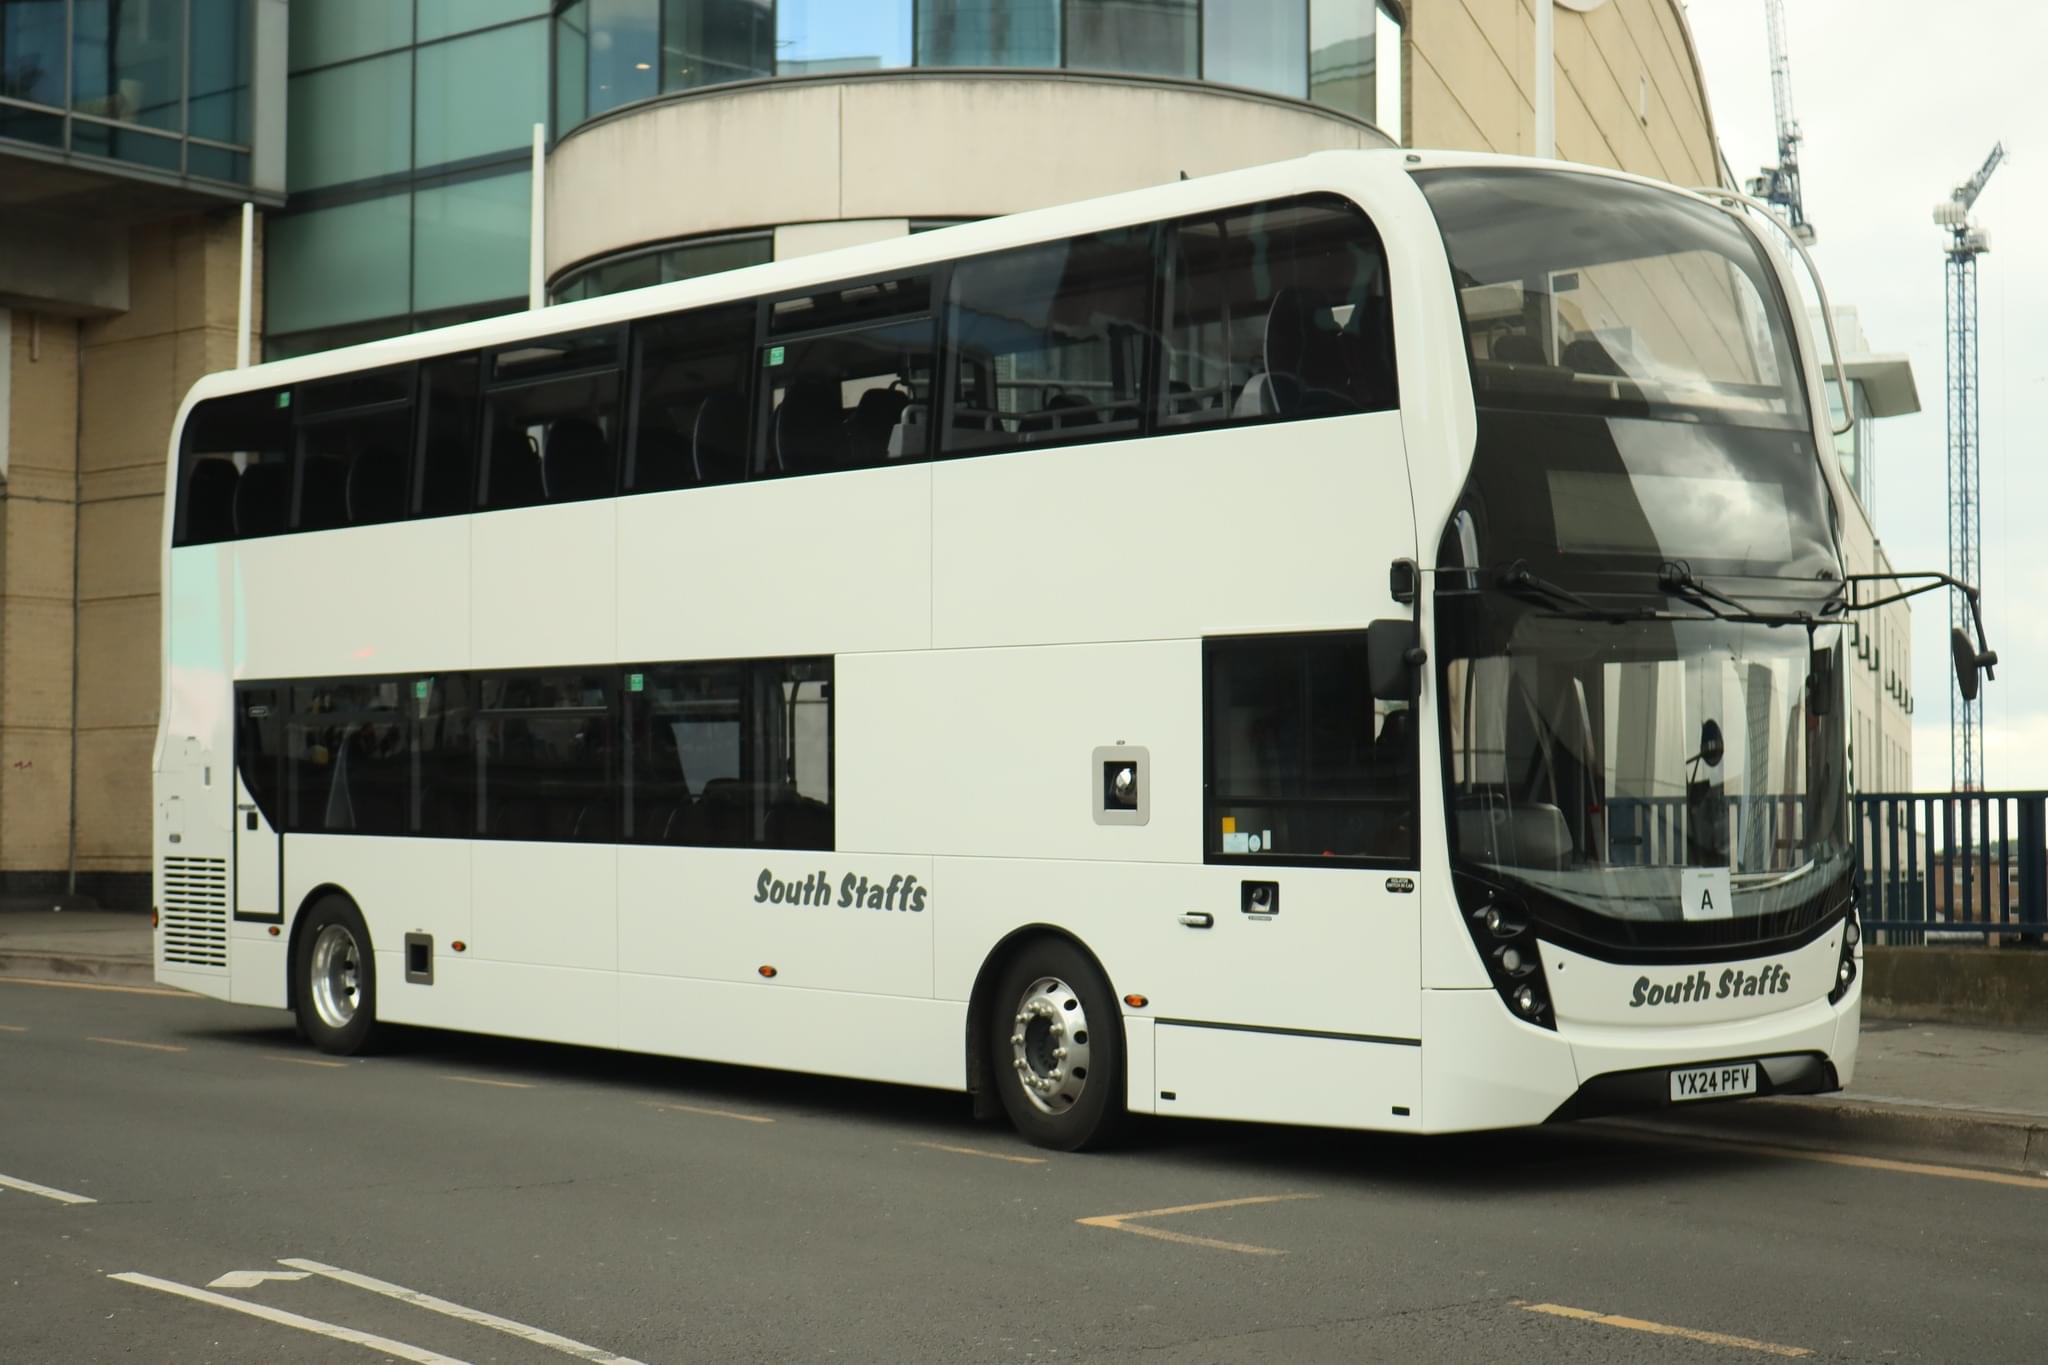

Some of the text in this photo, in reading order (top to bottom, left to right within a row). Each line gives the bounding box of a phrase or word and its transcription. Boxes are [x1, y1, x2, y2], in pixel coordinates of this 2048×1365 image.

[753, 867, 927, 912] South Staffs
[1701, 888, 1713, 910] A
[1629, 963, 1791, 1007] South Staffs
[1678, 1067, 1749, 1095] YX24 PFV
